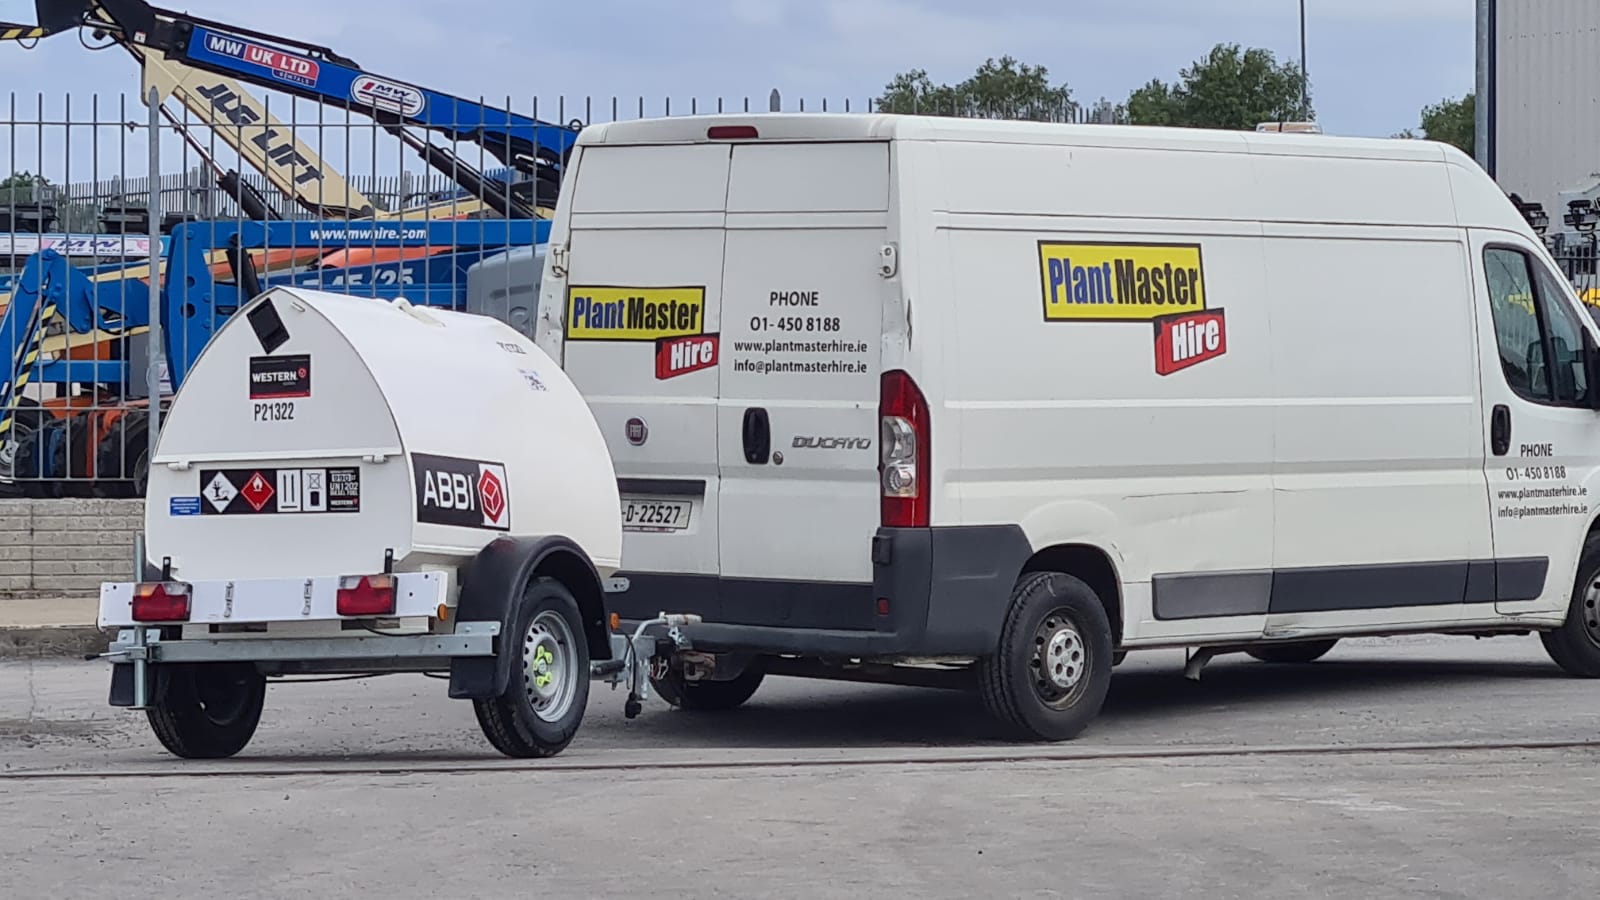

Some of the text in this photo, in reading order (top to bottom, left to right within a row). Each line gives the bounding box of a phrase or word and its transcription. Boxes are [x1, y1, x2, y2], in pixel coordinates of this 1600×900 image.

[210, 36, 310, 74] MW UK LTD
[376, 84, 411, 97] MW
[195, 83, 325, 184] JLG LIFT
[769, 291, 819, 307] PHONE
[777, 317, 803, 331] 450
[806, 317, 840, 331] 8188
[734, 340, 867, 355] www.plantmasterhire.ie
[1171, 318, 1220, 363] Hire
[670, 340, 713, 371] Hire
[734, 359, 867, 375] info@plantmasterhire.ie
[252, 371, 297, 383] WESTERN
[254, 402, 294, 421] P21322
[791, 436, 872, 450] DUCATO
[1520, 443, 1552, 457] PHONE
[1525, 466, 1542, 480] 450
[1543, 465, 1566, 479] 8188
[423, 470, 475, 511] ABBI
[1498, 485, 1588, 501] www.plantmasterhire.ie
[1498, 503, 1588, 519] info@plantmasterhire.ie
